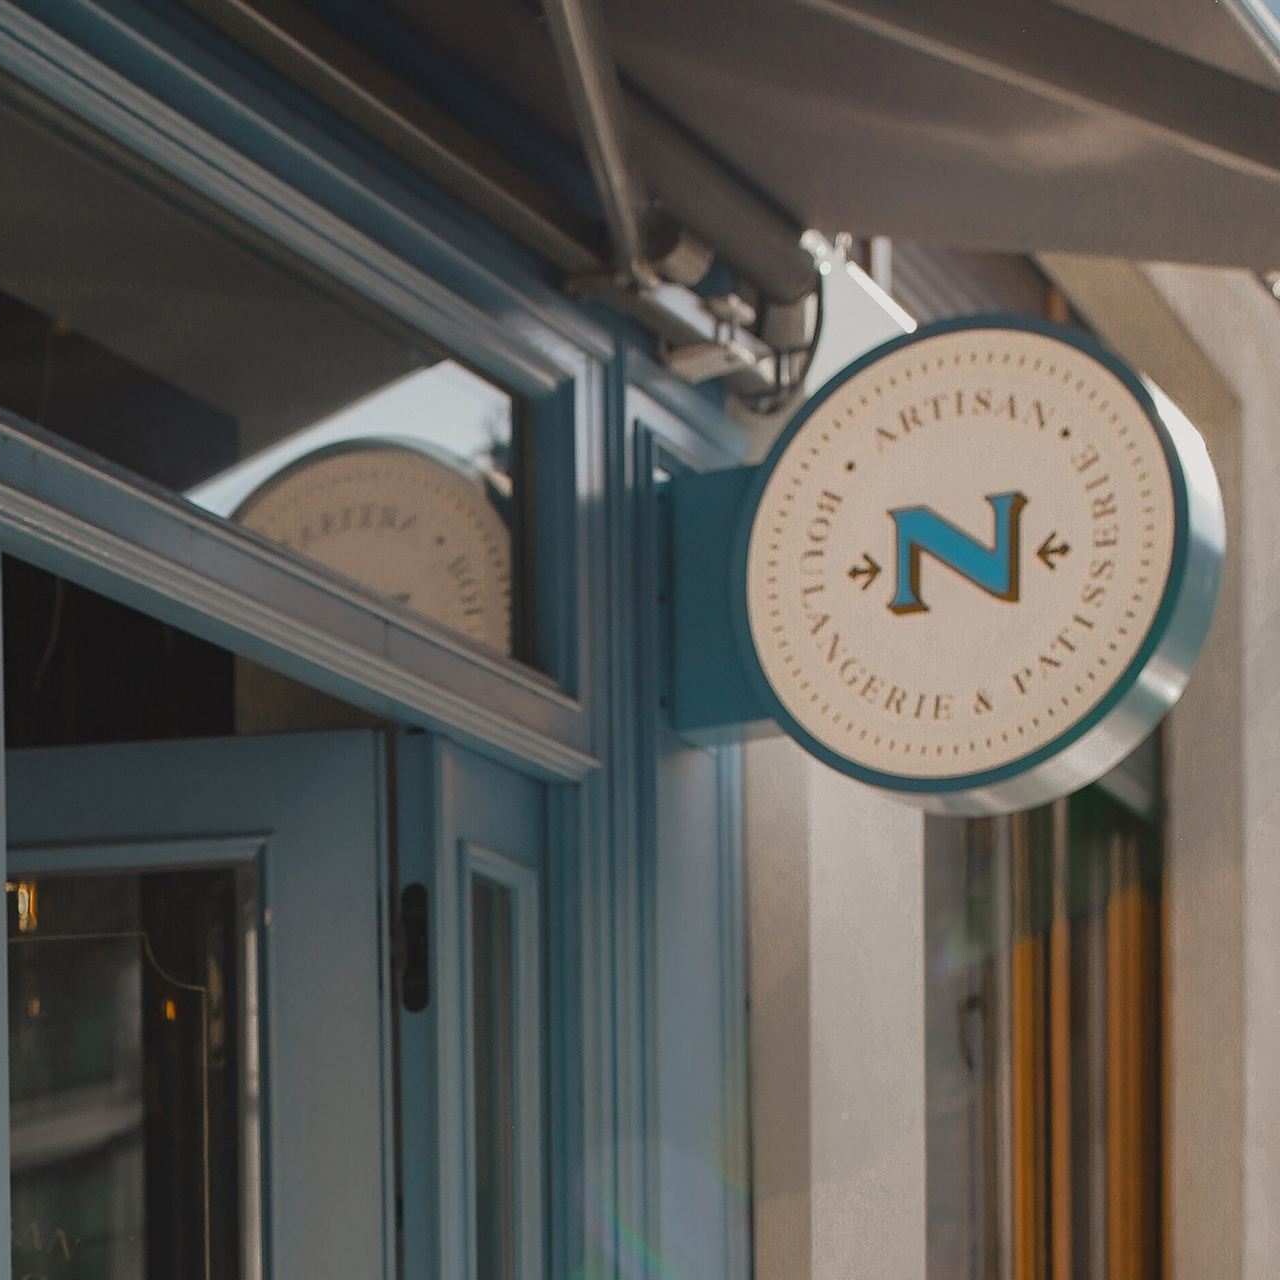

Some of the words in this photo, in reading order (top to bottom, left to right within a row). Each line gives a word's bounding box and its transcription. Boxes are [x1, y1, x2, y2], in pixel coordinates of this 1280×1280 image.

[875, 387, 1056, 453] ARTISAN
[799, 489, 955, 722] BOULANGERIE
[973, 688, 993, 715] &
[1013, 443, 1119, 696] PATISSERIE
[886, 490, 1028, 615] N
[13, 1219, 81, 1263] AN
